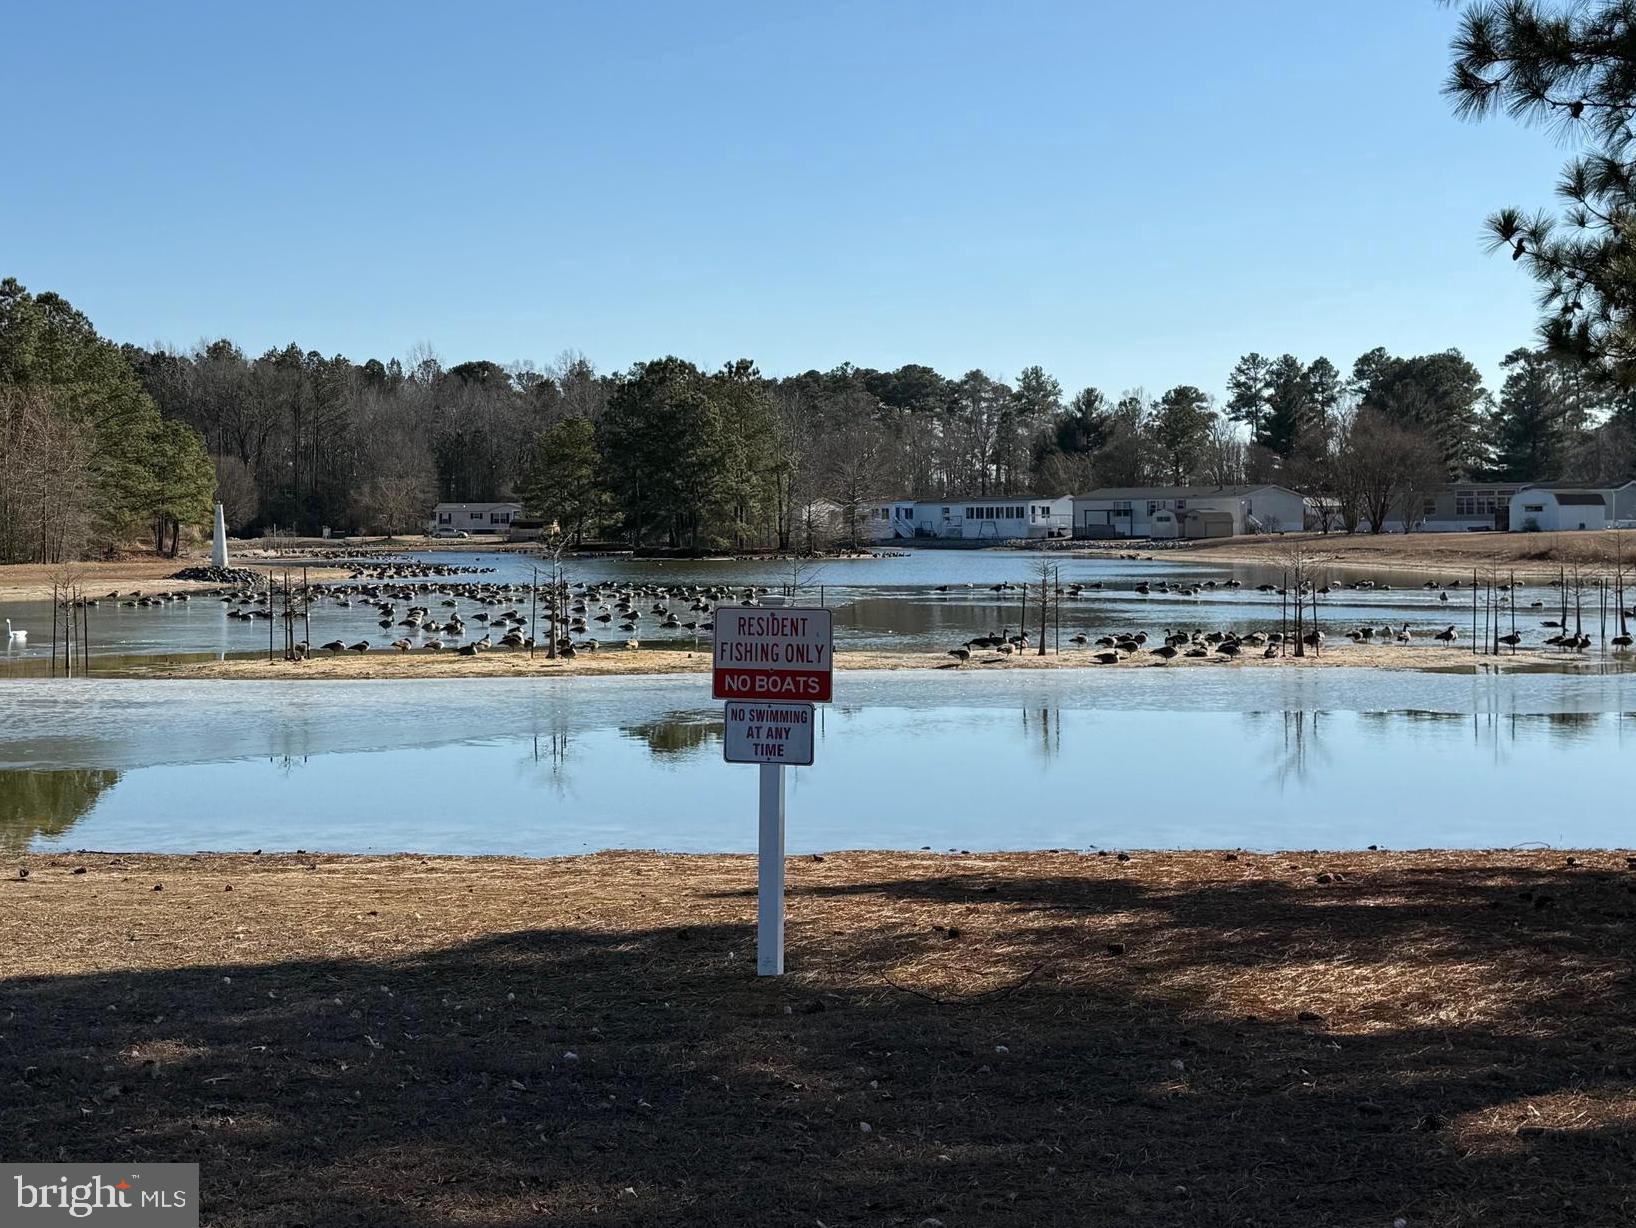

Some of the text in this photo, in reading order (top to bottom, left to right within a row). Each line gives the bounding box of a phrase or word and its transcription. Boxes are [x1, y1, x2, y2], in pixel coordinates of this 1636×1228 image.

[738, 616, 808, 637] RESIDENT
[720, 642, 825, 664] FISHING ONLY
[724, 674, 820, 694] NO BOATS
[730, 708, 808, 724] NO SWIMMING
[746, 726, 791, 740] AT ANY
[753, 743, 785, 757] TIME
